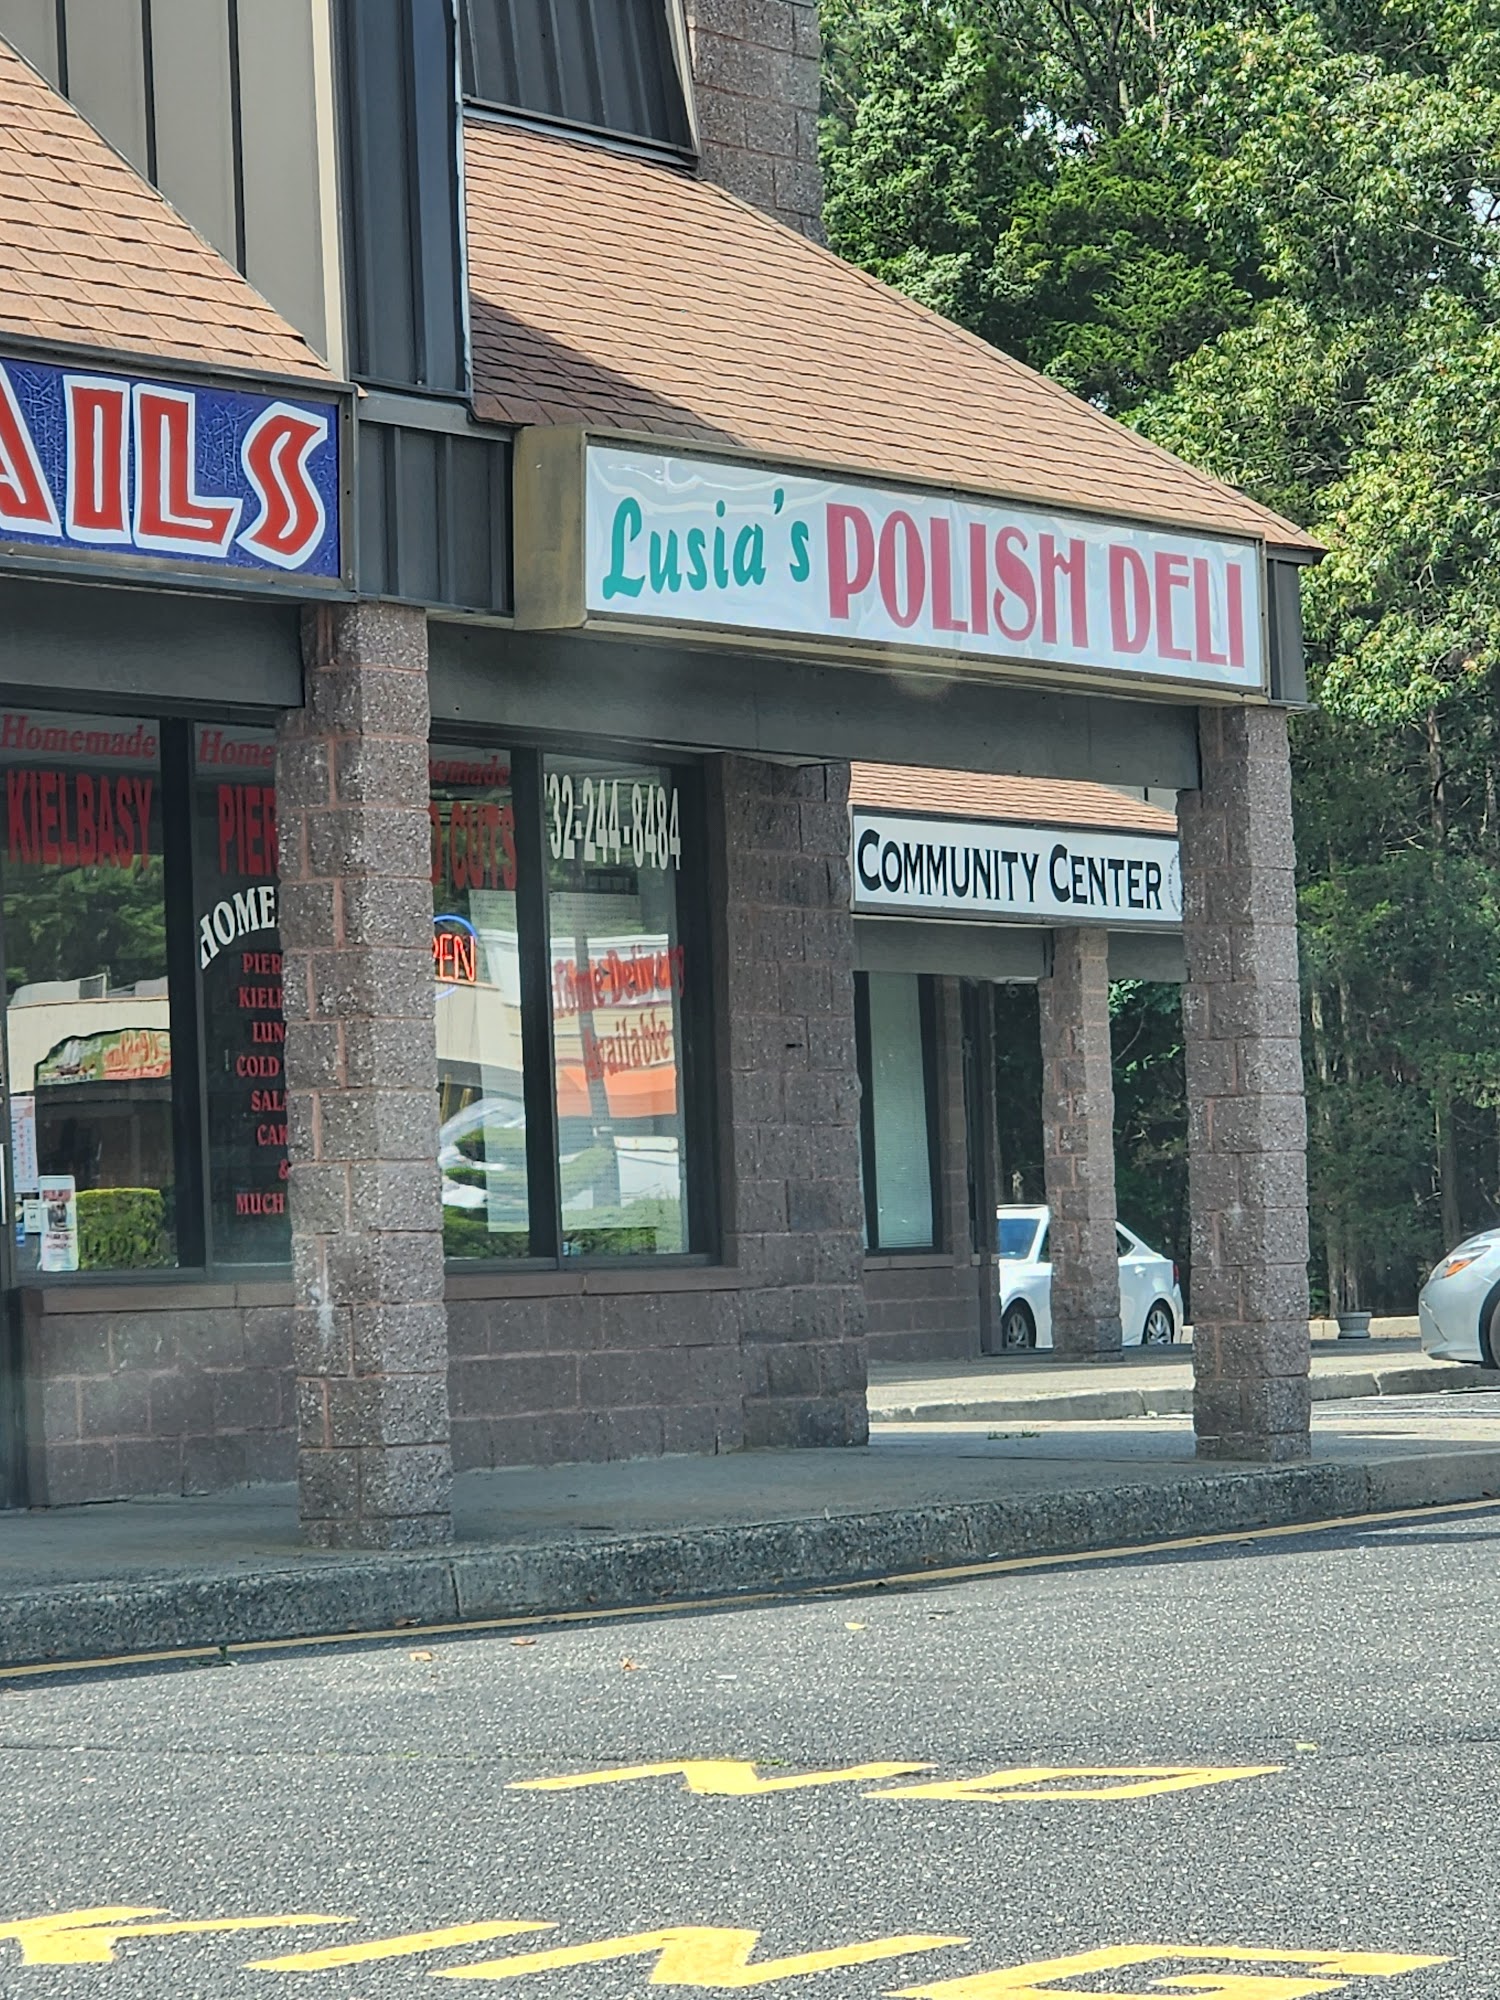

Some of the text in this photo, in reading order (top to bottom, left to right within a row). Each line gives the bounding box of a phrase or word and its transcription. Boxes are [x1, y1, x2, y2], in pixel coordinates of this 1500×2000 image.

[603, 488, 1245, 668] Lusia's POLISH DELI
[1, 714, 156, 760] Homemade
[7, 767, 152, 870] KIELBASY
[451, 801, 517, 891] CUTS
[544, 773, 681, 871] 32-244-8484
[858, 828, 1039, 903] COMMUNITY
[1049, 843, 1162, 911] CENTER
[236, 1055, 280, 1077] COLD
[584, 1008, 670, 1080] Available
[235, 1192, 285, 1215] MUCH
